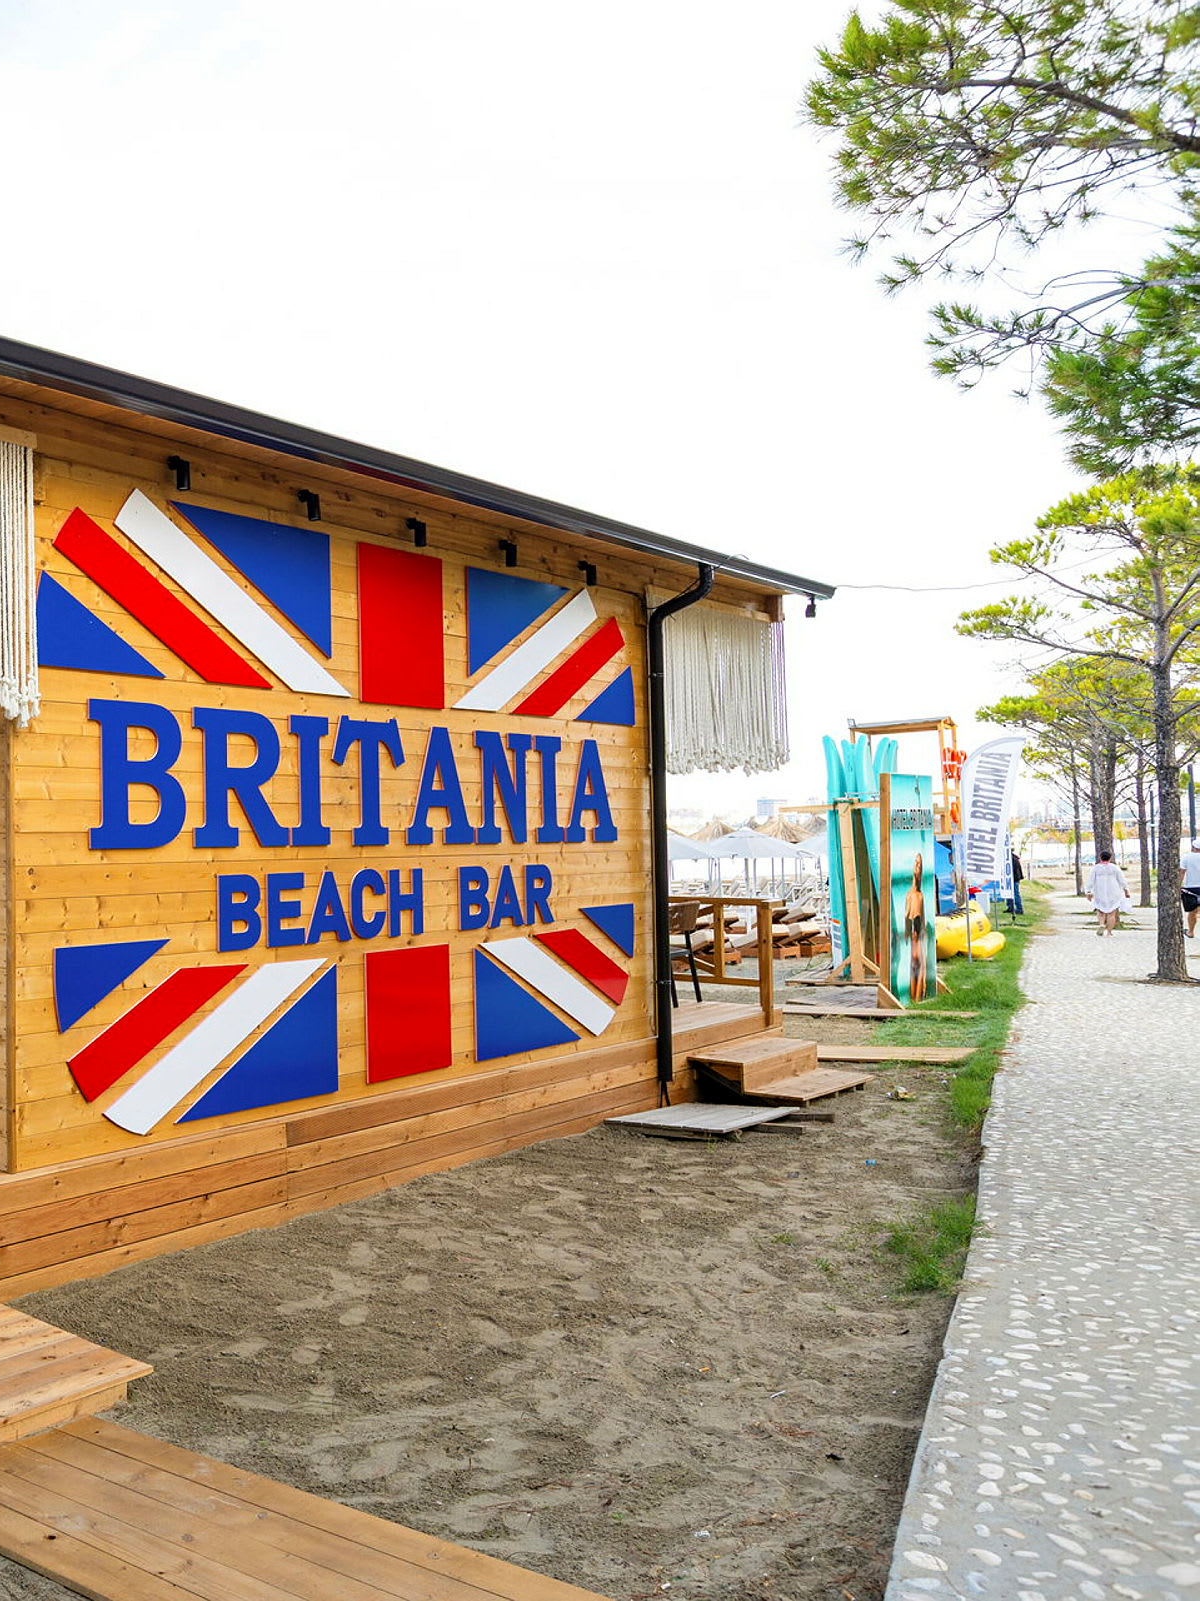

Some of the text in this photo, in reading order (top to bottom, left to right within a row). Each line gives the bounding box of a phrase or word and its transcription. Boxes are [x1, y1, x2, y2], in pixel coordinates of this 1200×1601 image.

[88, 698, 618, 850] BRITANIA
[966, 751, 1012, 876] HOTEL BRITANIA
[217, 864, 555, 953] BEACH BAR
